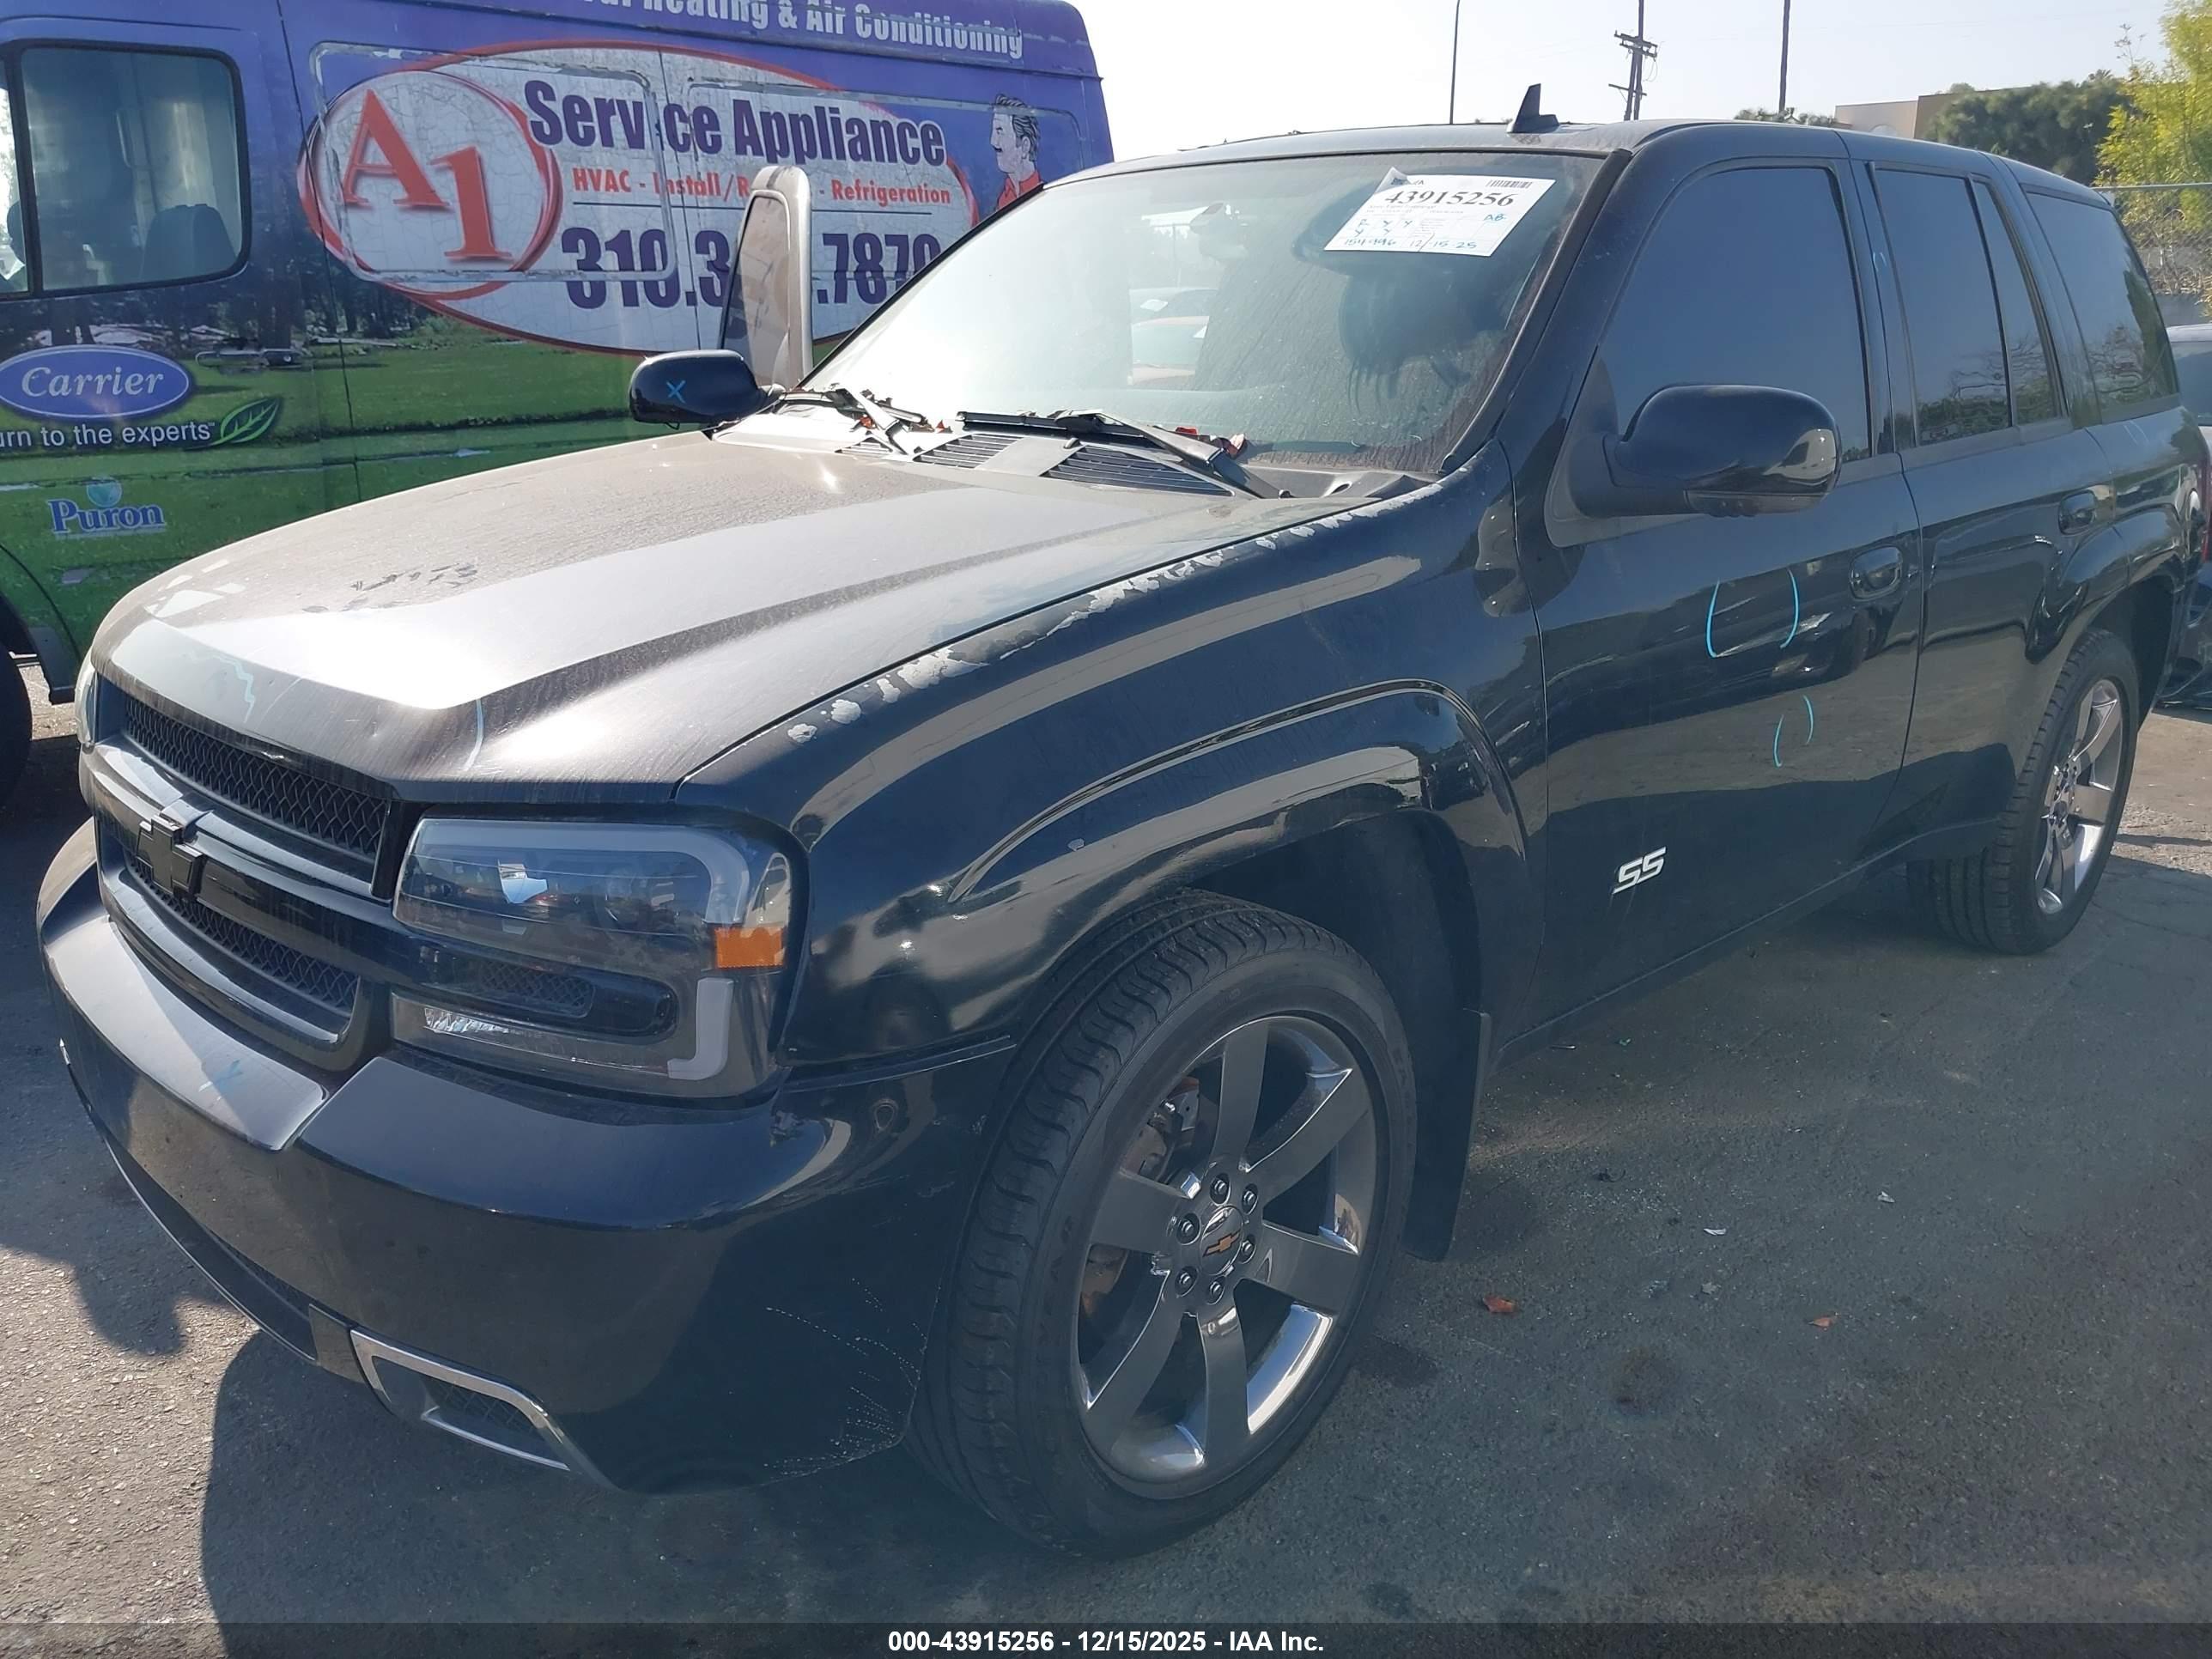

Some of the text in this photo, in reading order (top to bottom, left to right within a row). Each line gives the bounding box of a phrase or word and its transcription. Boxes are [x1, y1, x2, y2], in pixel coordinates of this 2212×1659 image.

[777, 0, 798, 28] &
[806, 0, 846, 34] Air
[854, 3, 1023, 59] Conditioning
[525, 80, 945, 166] Servce Appliance
[341, 89, 513, 261] A1
[573, 167, 631, 193] HVAC
[831, 179, 951, 207] Refrigeration
[1385, 191, 1518, 206] 43915256
[21, 367, 164, 397] Carrier
[43, 427, 64, 447] to
[75, 424, 112, 445] the
[122, 422, 210, 447] experts
[48, 498, 166, 534] Puron
[1612, 846, 1667, 895] SS
